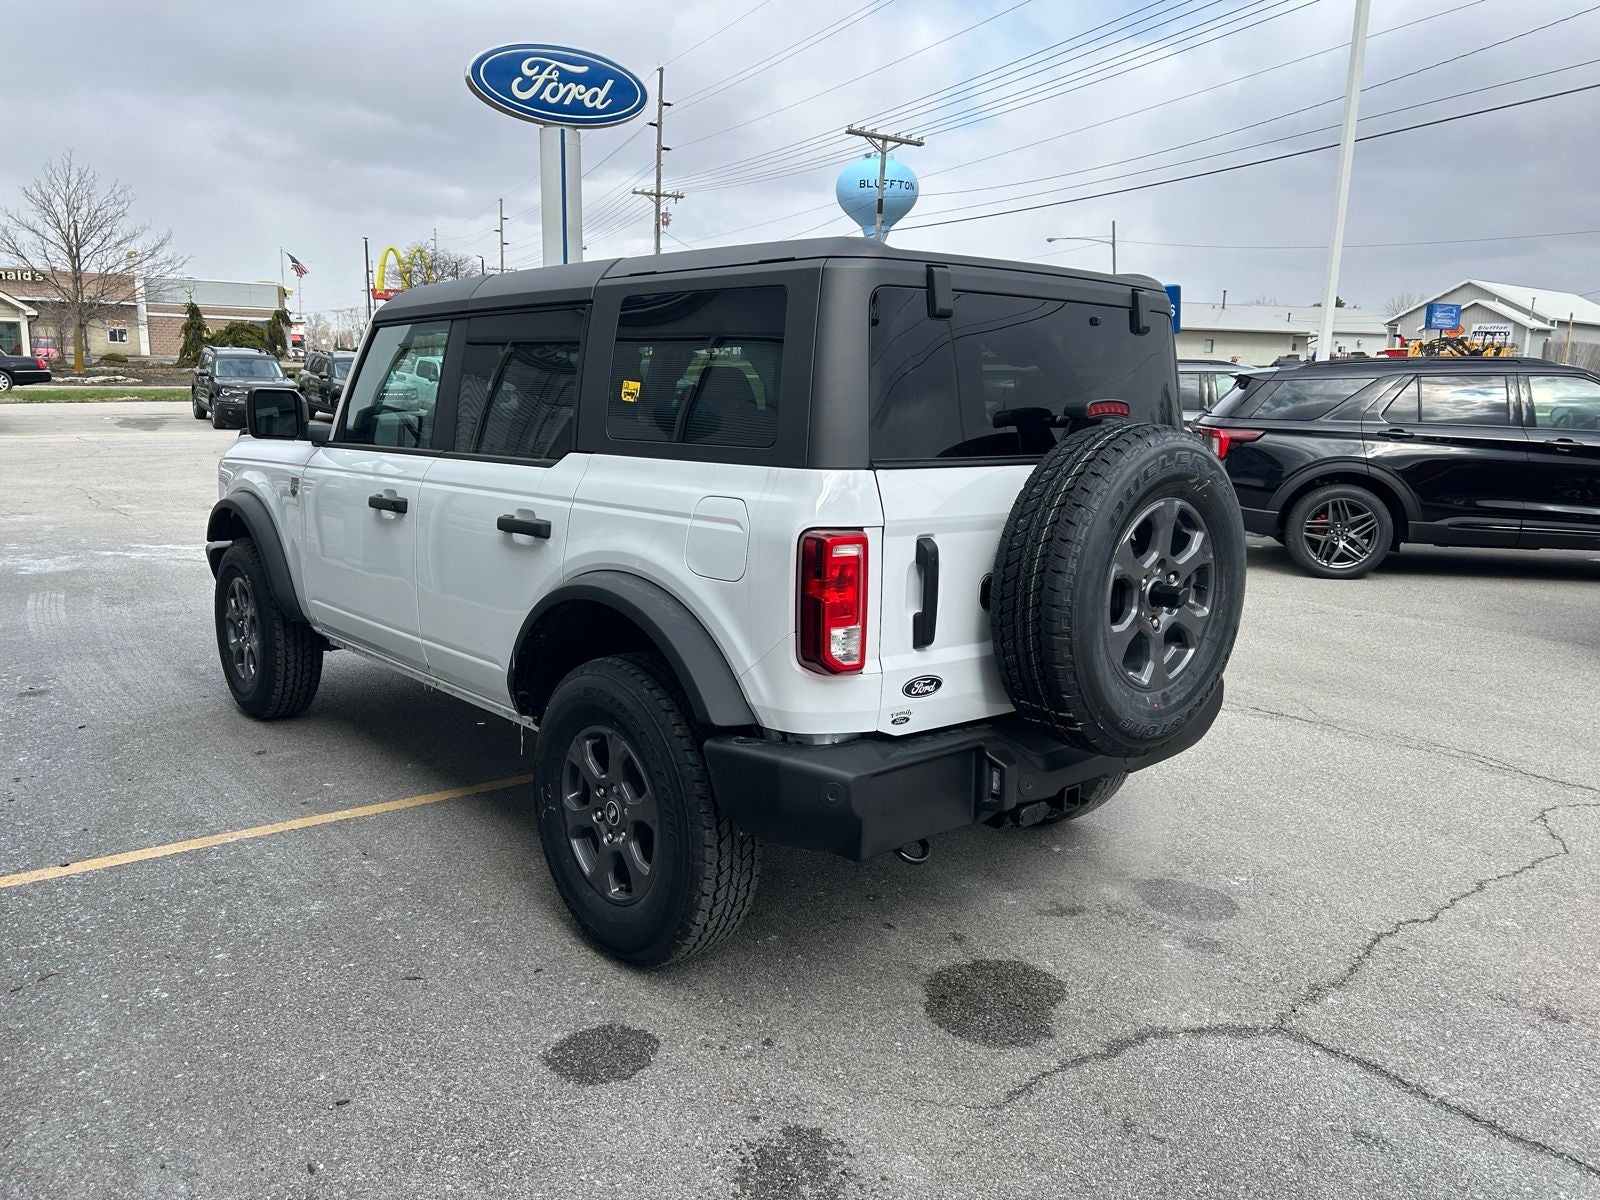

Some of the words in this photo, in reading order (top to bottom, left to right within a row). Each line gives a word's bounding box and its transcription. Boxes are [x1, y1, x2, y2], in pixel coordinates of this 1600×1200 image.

[511, 56, 615, 109] Ford
[859, 179, 915, 191] BLUFFTON
[1109, 450, 1208, 530] DUELER
[912, 680, 936, 694] Ford
[891, 709, 913, 718] Family
